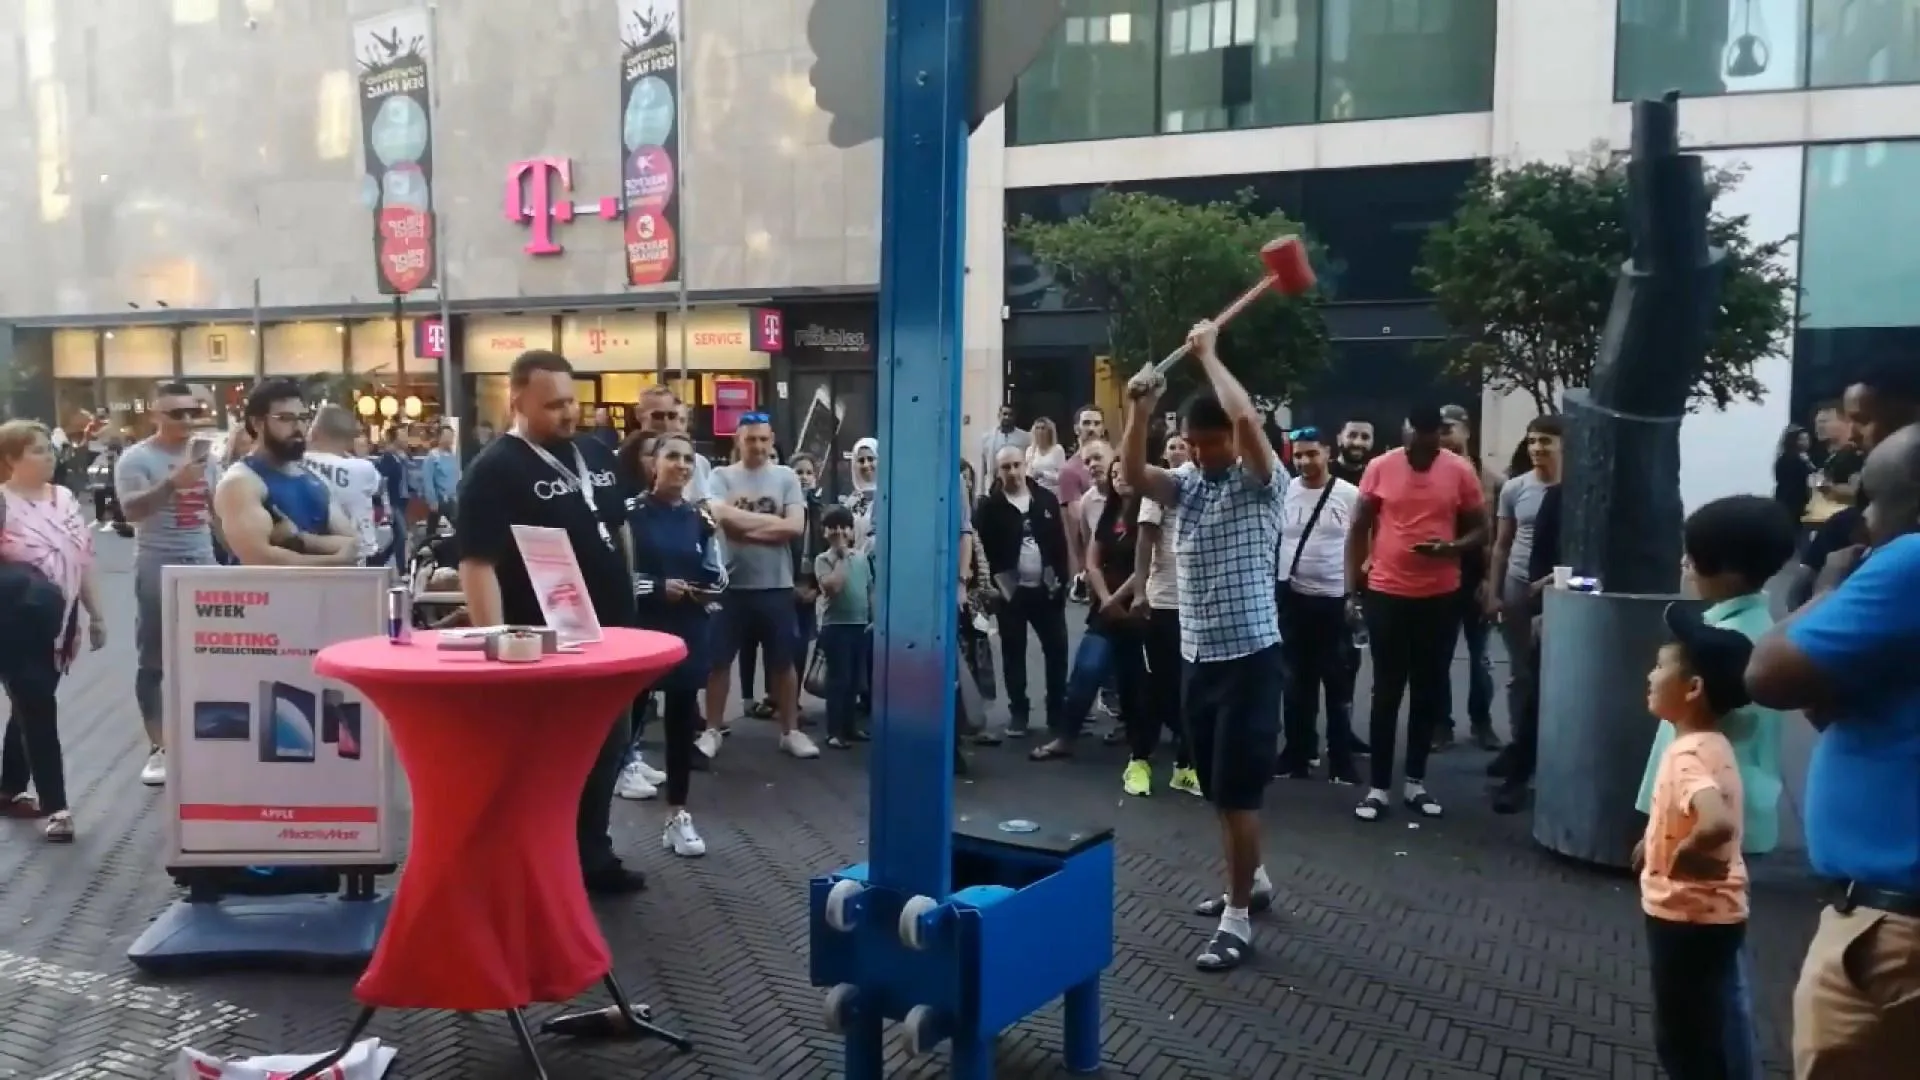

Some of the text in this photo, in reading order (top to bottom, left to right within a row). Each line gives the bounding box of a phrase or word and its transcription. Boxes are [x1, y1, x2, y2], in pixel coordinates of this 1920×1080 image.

[491, 338, 526, 349] PHONE
[694, 332, 743, 345] SERVICE
[195, 590, 270, 605] MERKEN
[195, 605, 246, 618] WEEK
[194, 632, 280, 647] KORTING
[261, 808, 294, 819] APPLE
